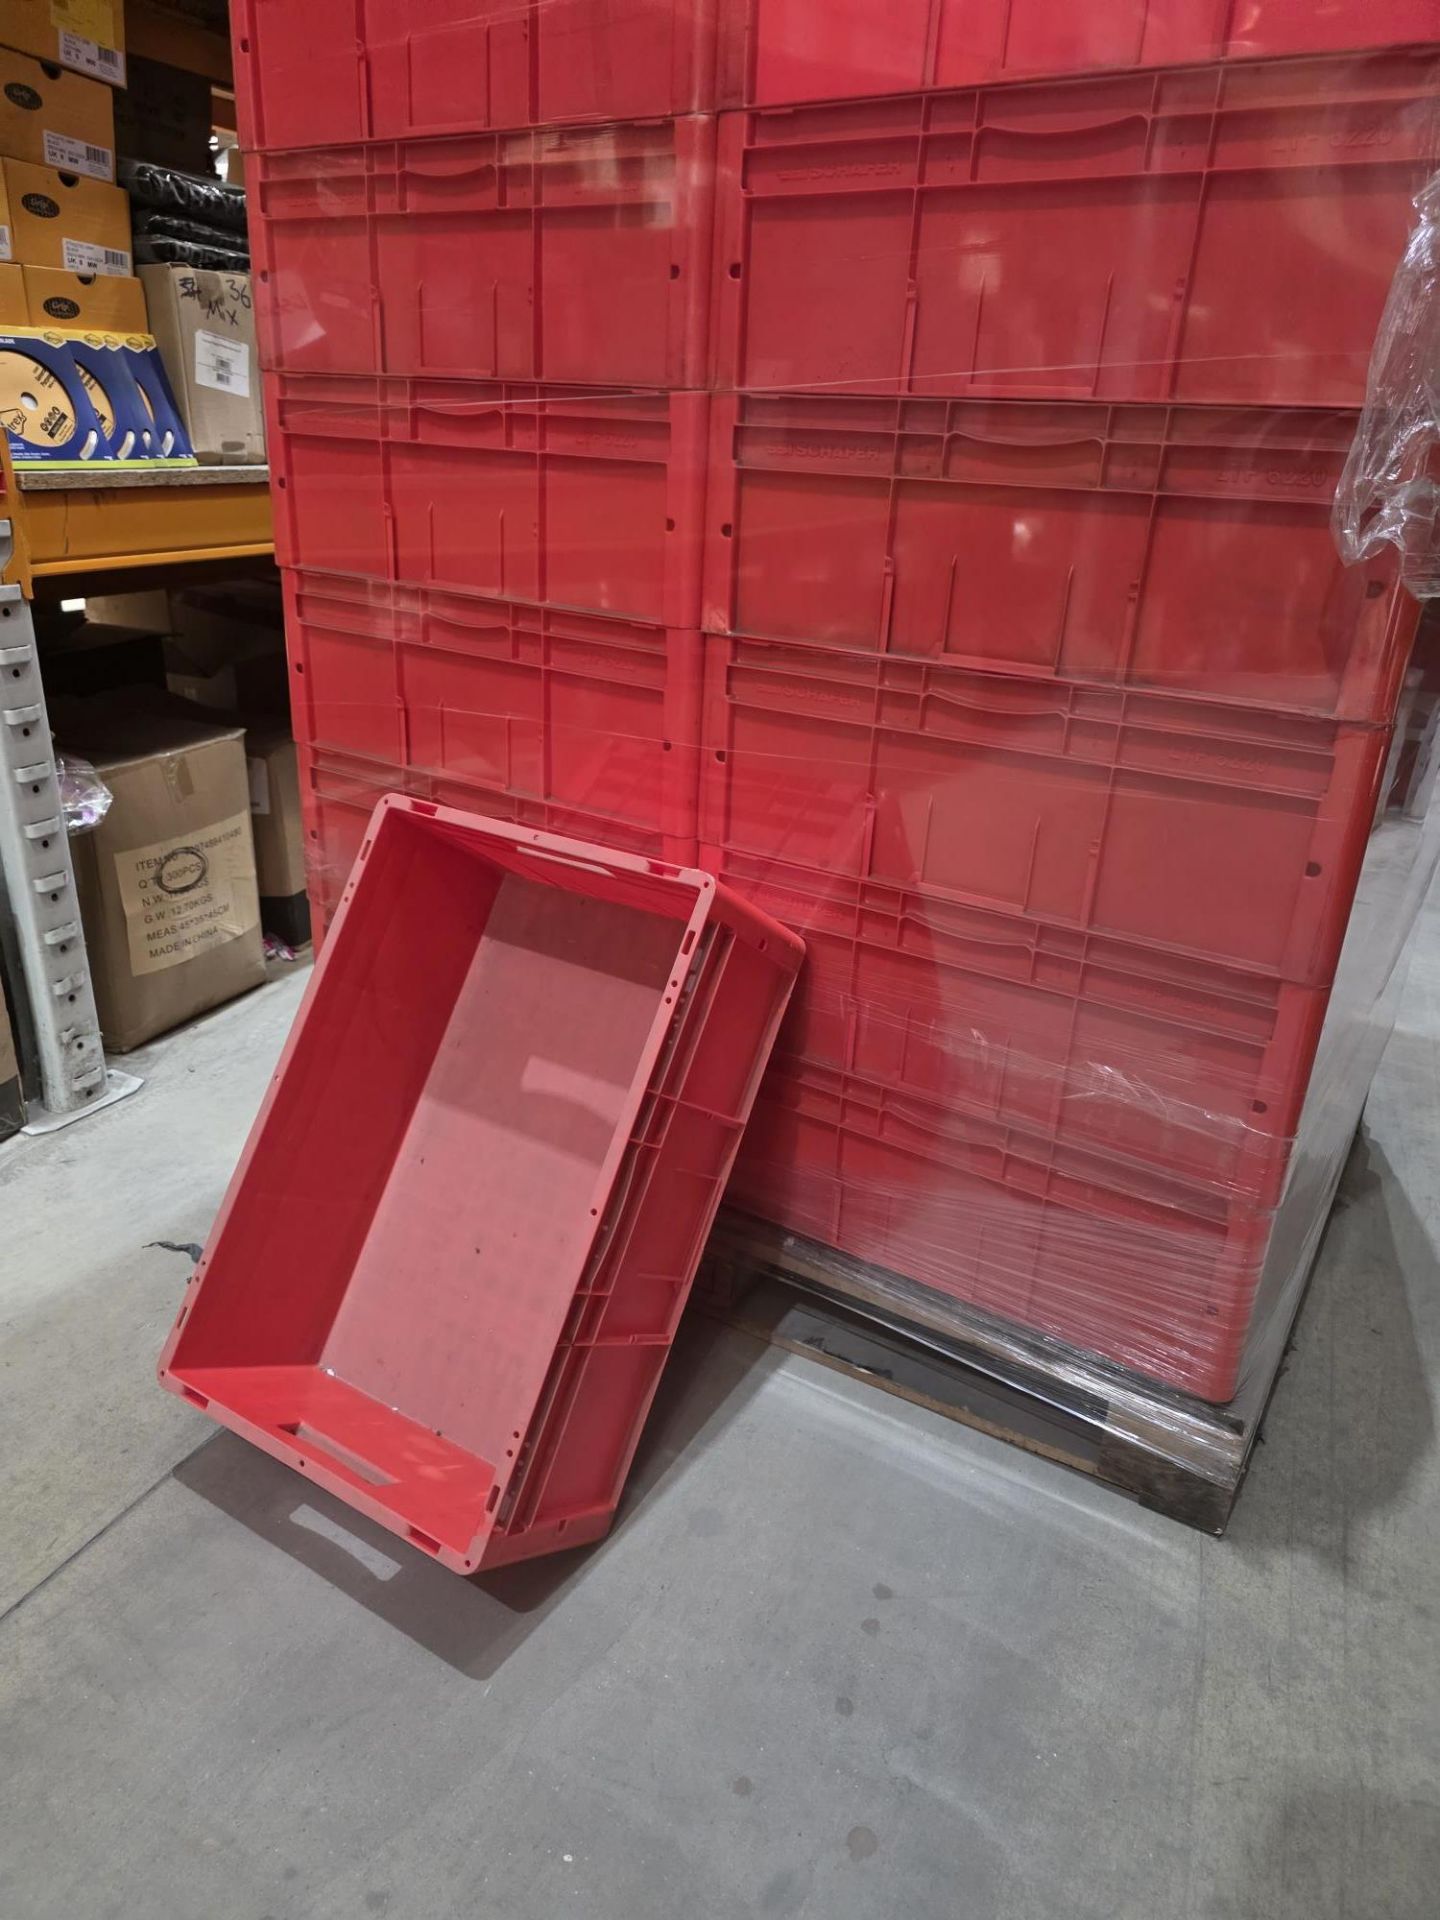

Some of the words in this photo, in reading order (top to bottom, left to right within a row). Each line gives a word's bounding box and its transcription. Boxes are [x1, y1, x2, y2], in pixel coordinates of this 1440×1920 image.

[225, 279, 251, 309] 36
[1265, 467, 1328, 488] 6220
[148, 942, 181, 958] MADE
[181, 937, 192, 947] IN
[192, 926, 219, 943] CHINA
